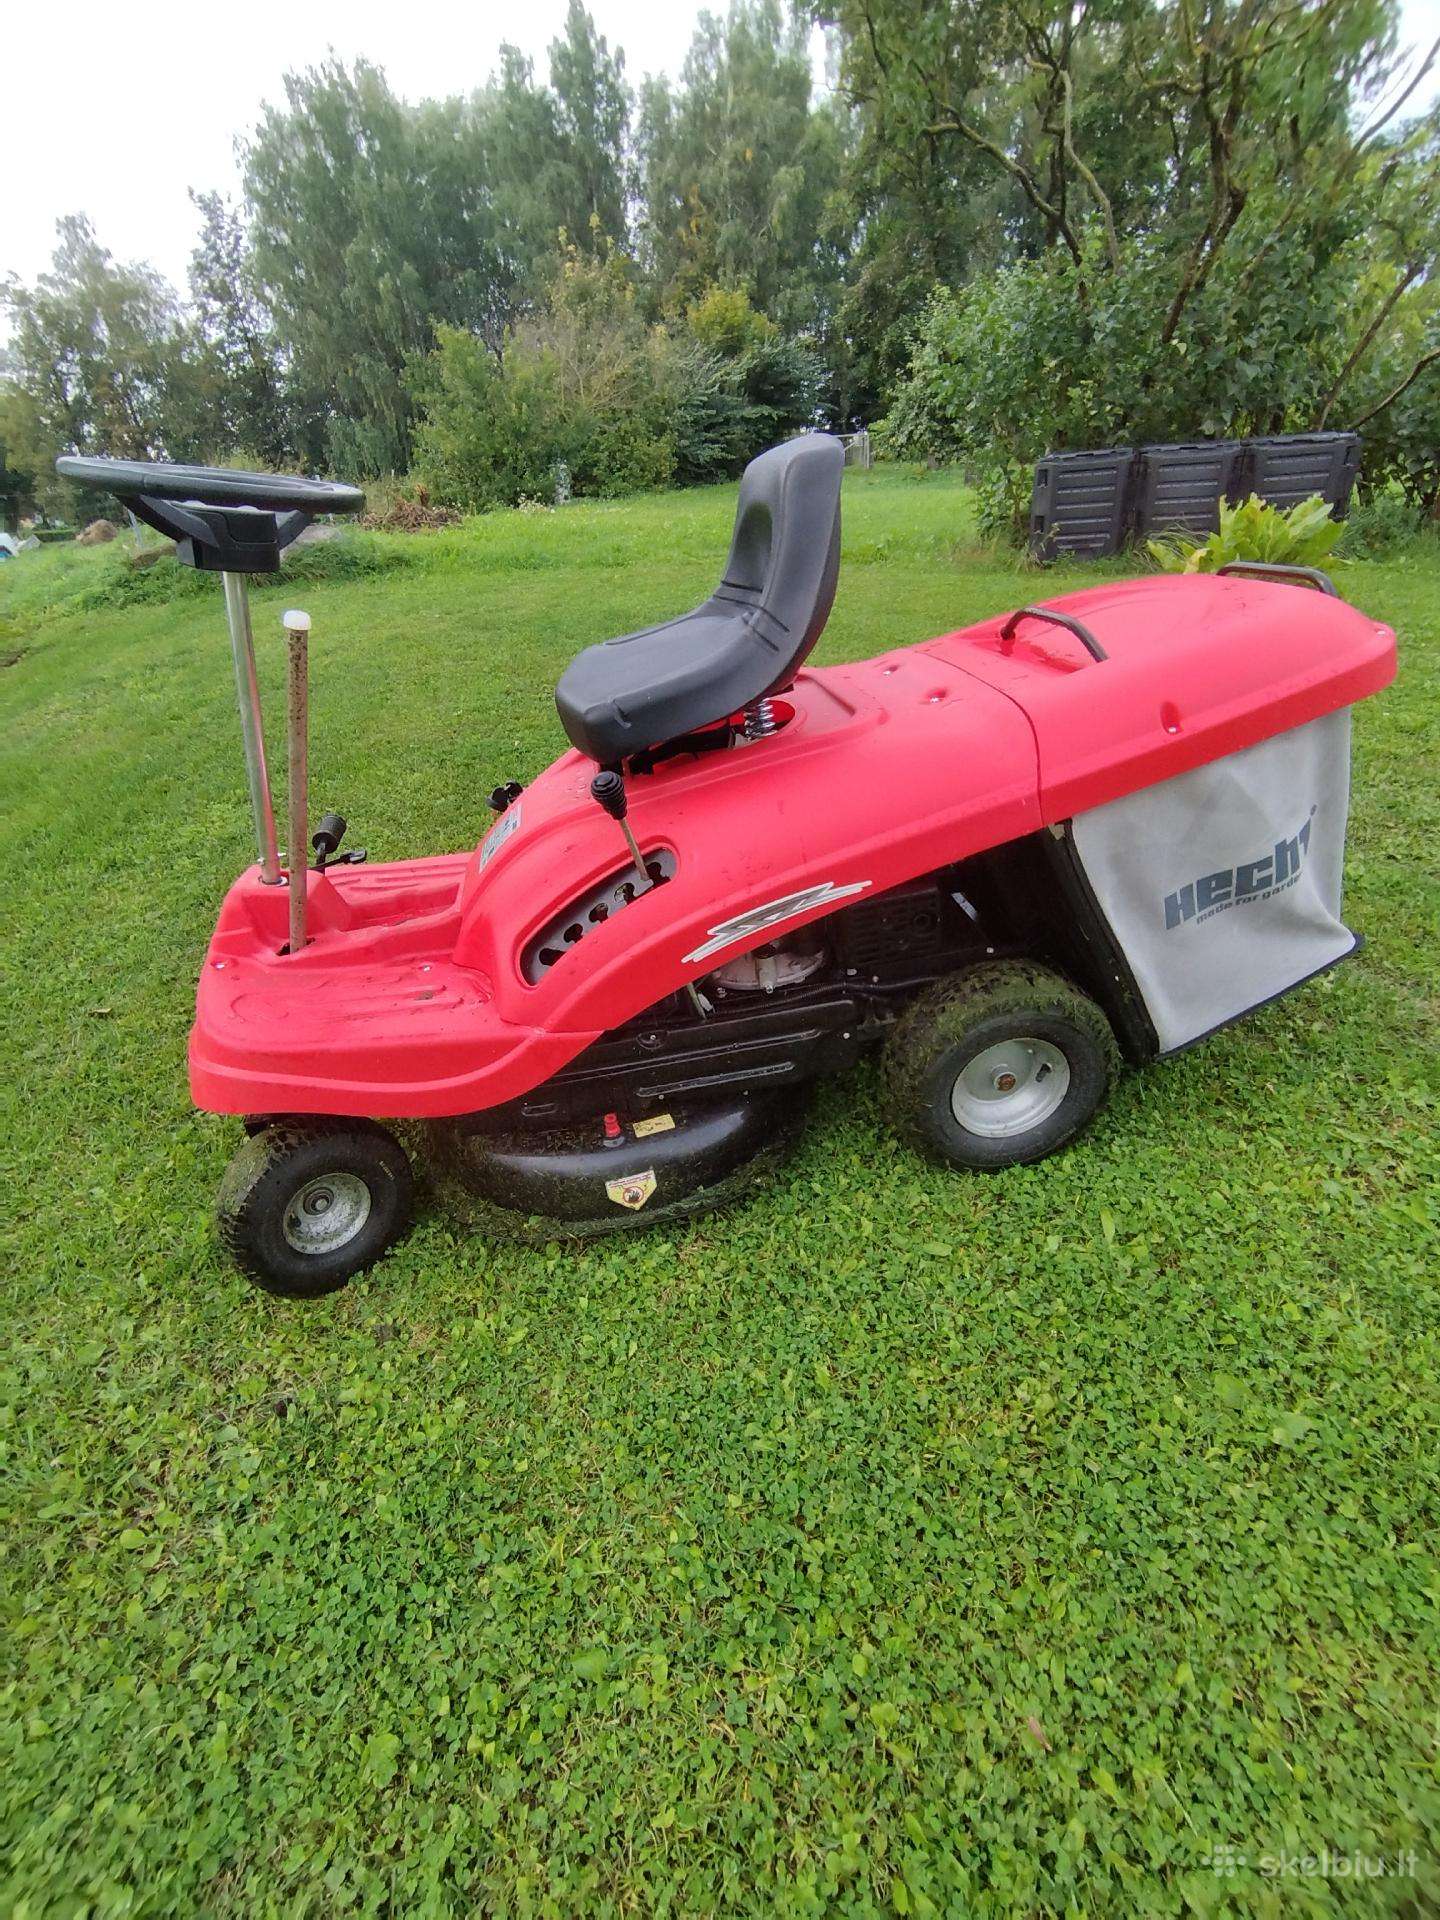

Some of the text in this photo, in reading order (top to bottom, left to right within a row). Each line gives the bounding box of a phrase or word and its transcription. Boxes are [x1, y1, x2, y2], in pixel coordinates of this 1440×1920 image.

[1196, 872, 1303, 925] made for garde
